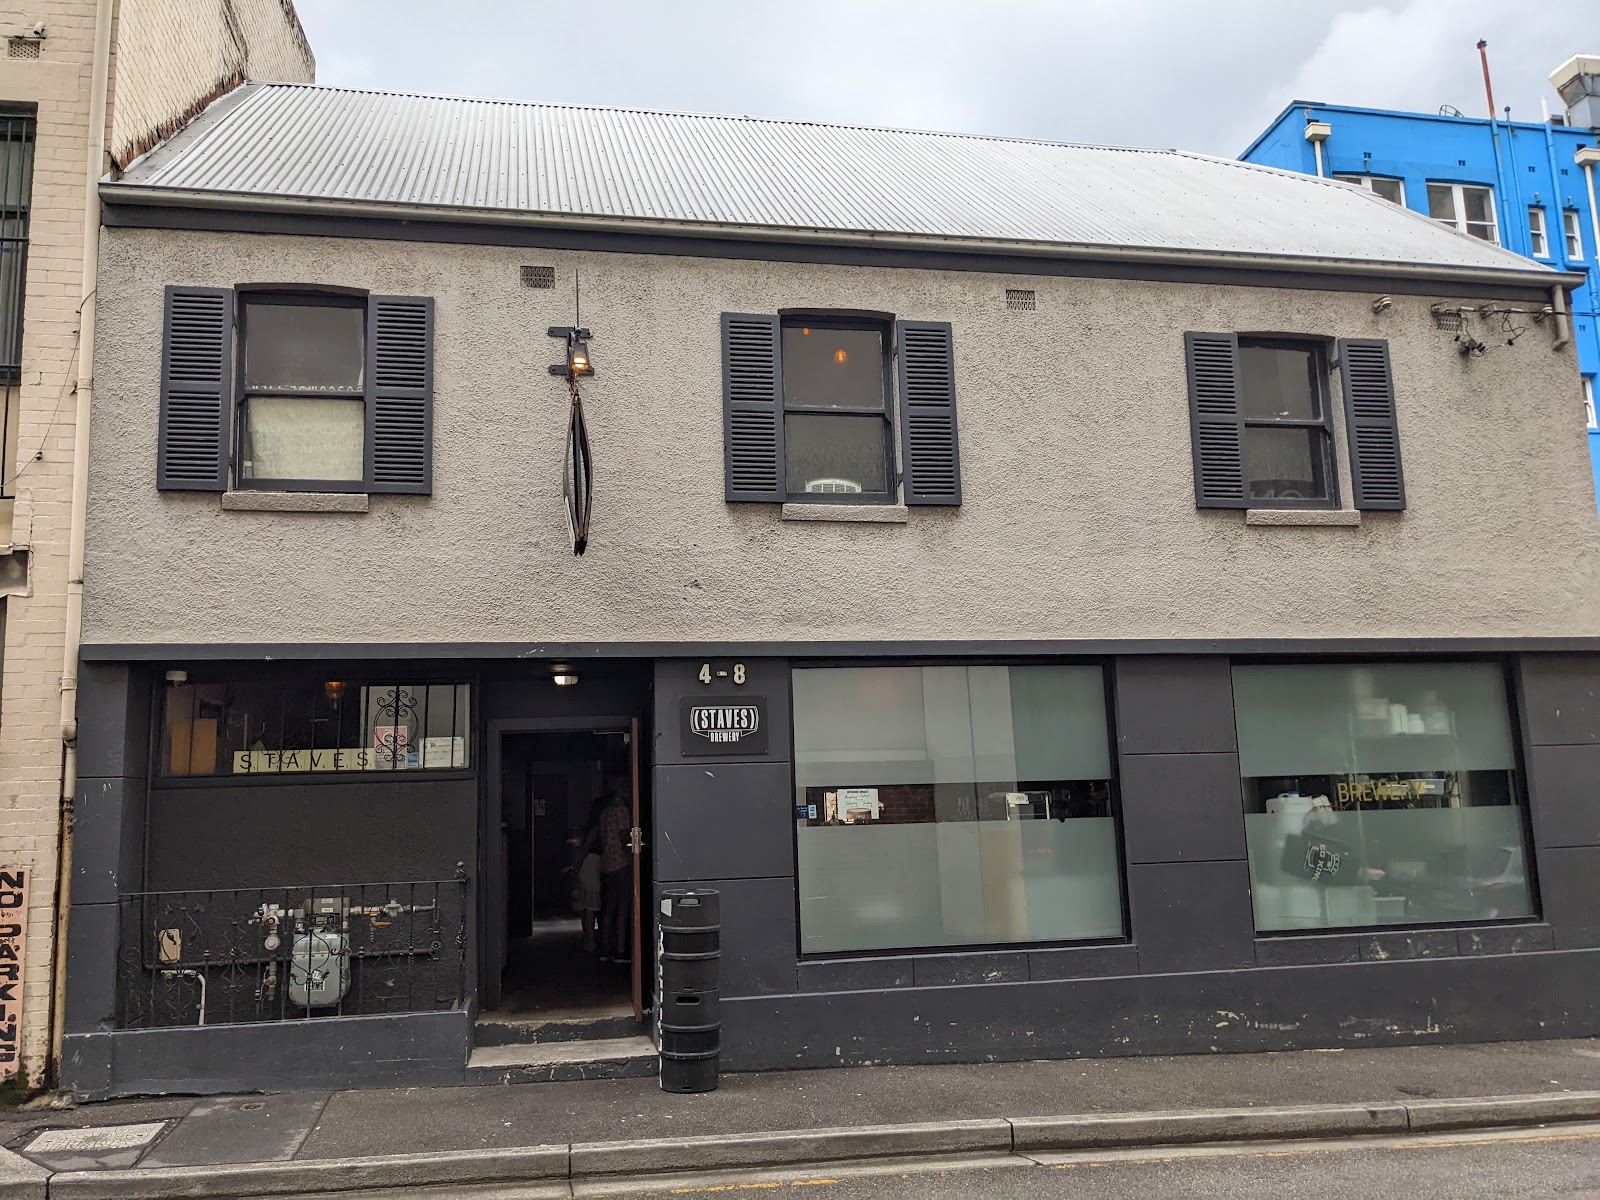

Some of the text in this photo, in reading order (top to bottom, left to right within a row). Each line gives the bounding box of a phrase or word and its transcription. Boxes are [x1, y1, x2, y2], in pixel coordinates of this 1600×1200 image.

[710, 731, 740, 742] BREWERY
[239, 752, 369, 769] STAVES
[1338, 781, 1425, 802] BREWERY
[0, 872, 25, 908] NO
